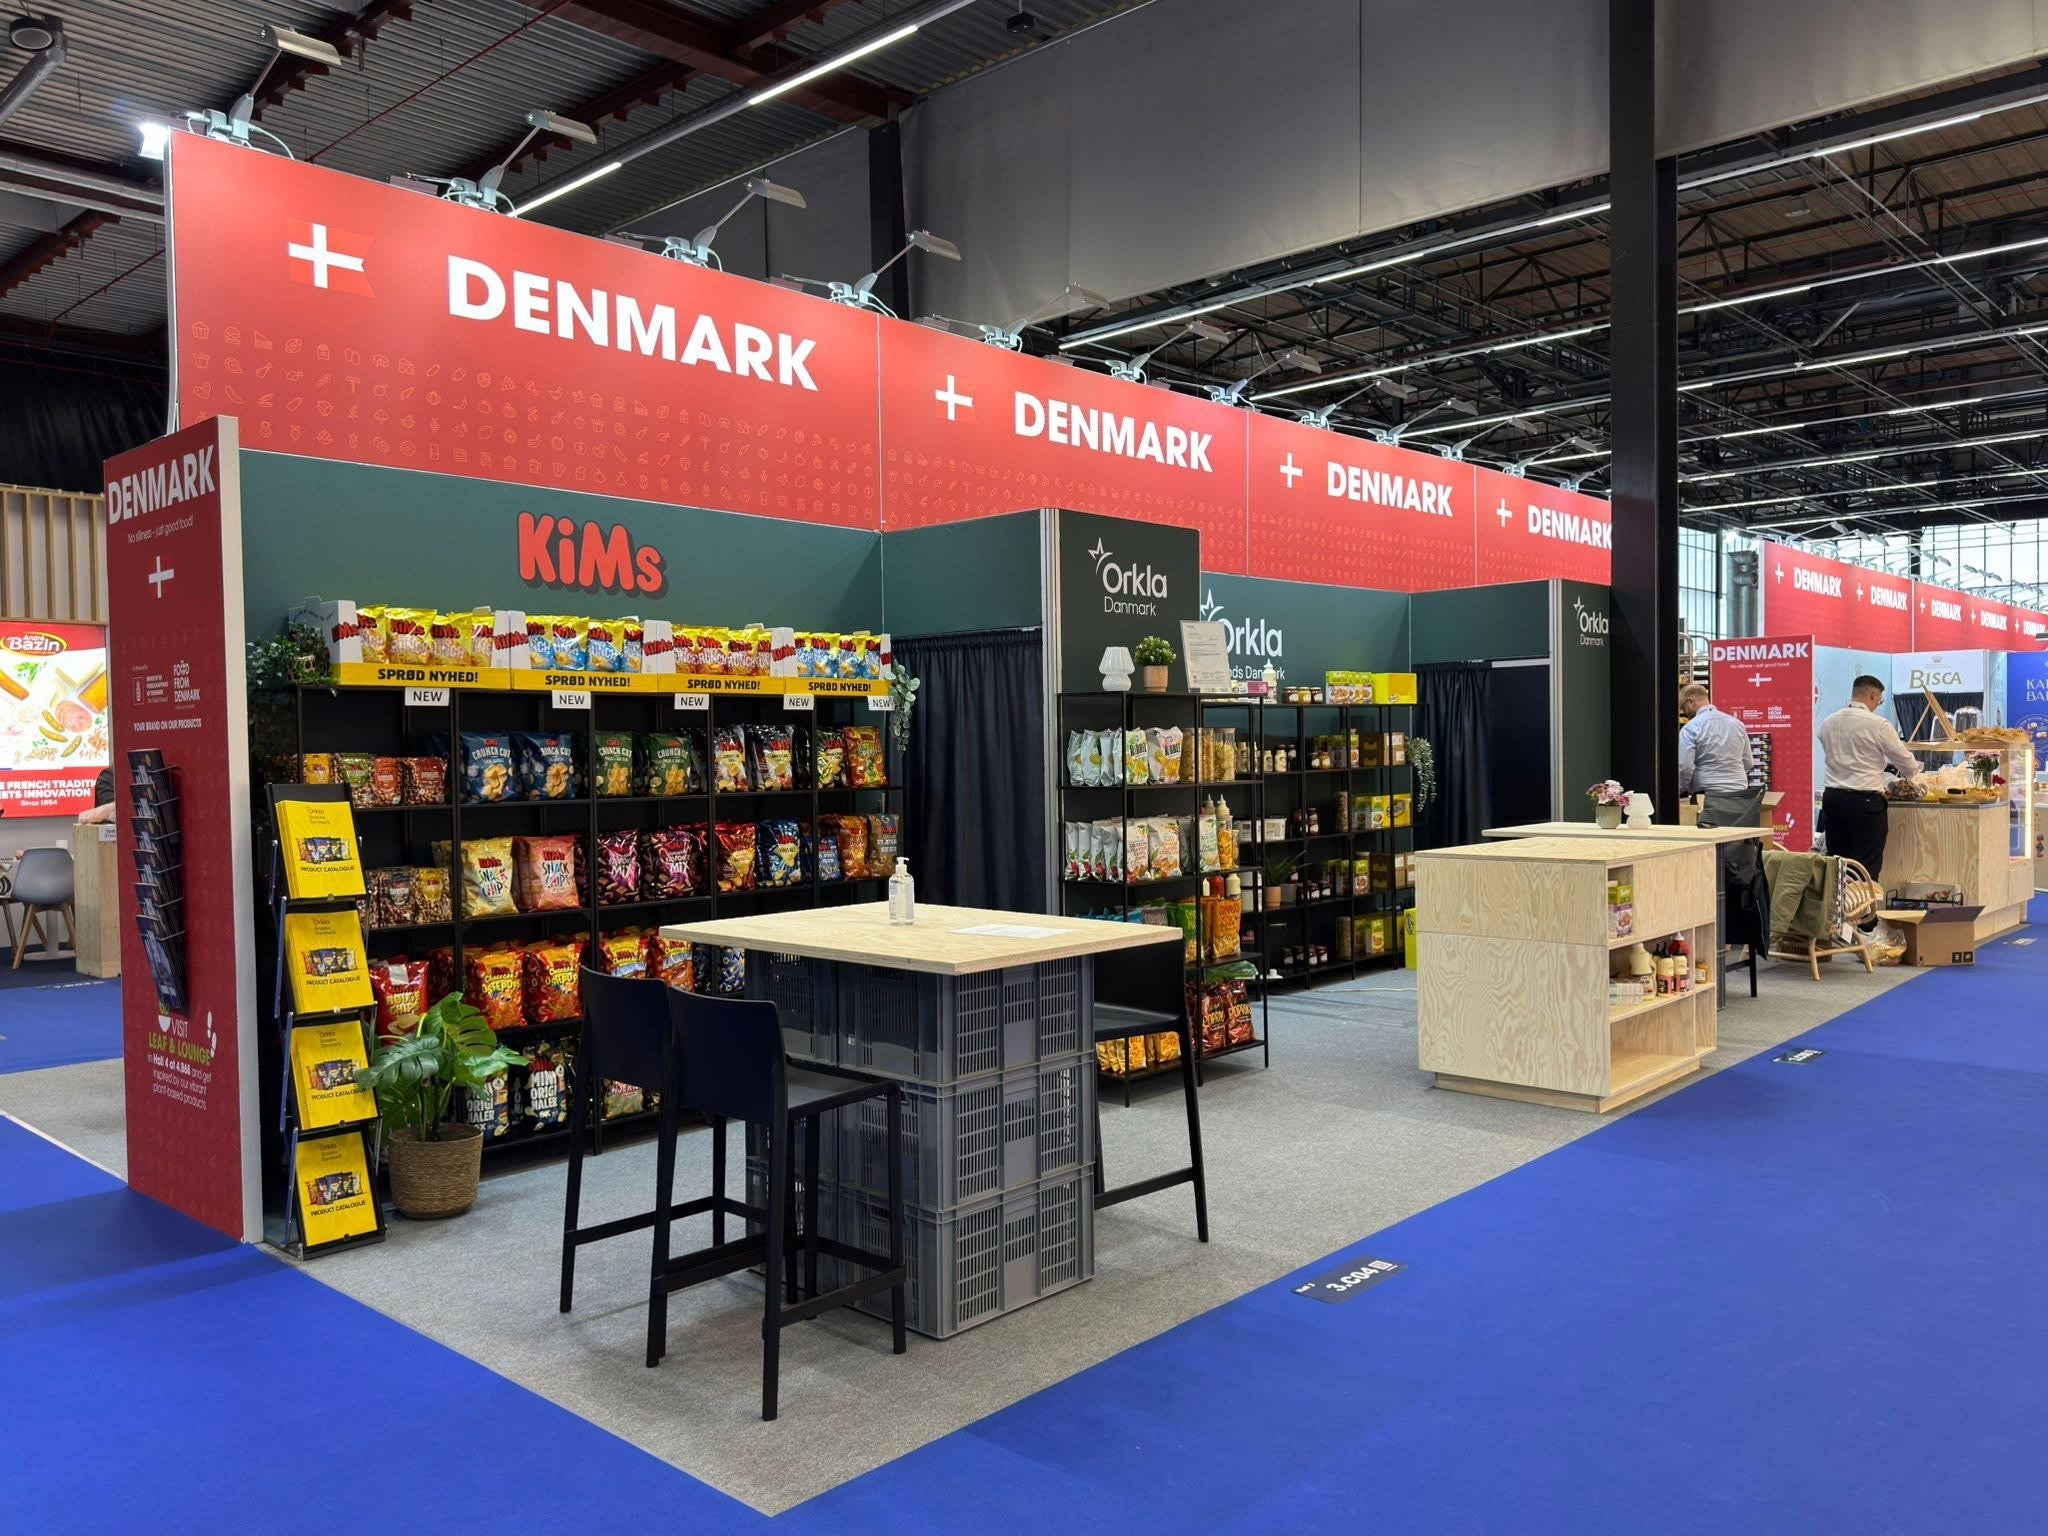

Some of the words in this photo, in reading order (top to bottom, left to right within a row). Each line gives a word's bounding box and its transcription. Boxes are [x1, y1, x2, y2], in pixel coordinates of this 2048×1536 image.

[447, 254, 819, 392] DENMARK
[1014, 389, 1214, 473] DENMARK
[108, 445, 215, 525] DENMARK
[1327, 461, 1453, 517] DENMARK
[1528, 504, 1612, 550] DENMARK
[518, 511, 664, 592] KiMs
[1103, 562, 1167, 598] Orkla
[1793, 566, 1842, 598] DENMARK
[1871, 585, 1908, 611] DENMARK
[1104, 596, 1157, 617] Danmark
[1931, 599, 1962, 622] DENMARK
[1580, 611, 1609, 634] Orkla
[1713, 642, 1809, 662] DENMARK
[174, 662, 190, 677] FOOD
[378, 668, 425, 681] SPRØD
[429, 671, 479, 683] NYHED!
[174, 677, 190, 689] FROM
[545, 675, 585, 686] SPRØD
[589, 677, 631, 687] NYHED!
[687, 679, 722, 689] SPRØD
[724, 681, 760, 690] NYHED!
[1910, 669, 1962, 689] BISCA
[808, 682, 838, 691] SPRØD
[840, 683, 871, 692] NYHED!
[174, 688, 201, 703] DENMARK
[413, 691, 443, 702] NEW
[559, 694, 585, 705] NEW
[680, 697, 704, 706] NEW
[789, 698, 810, 706] NEW
[872, 700, 890, 708] NEW
[133, 722, 145, 732] YOUR
[146, 721, 160, 731] BRAND
[160, 720, 168, 730] ON
[169, 719, 178, 729] OUR
[178, 718, 202, 729] PRODUCTS
[472, 746, 499, 760] CRUNCH
[7, 780, 51, 790] FRENCH
[52, 778, 97, 789] TRADITI
[24, 788, 91, 798] INNOVATION
[301, 865, 323, 873] PRODUCT
[323, 865, 355, 873] CATALOGUE
[542, 861, 569, 876] SNACK
[306, 978, 329, 986] PRODUCT
[329, 976, 361, 985] CATALOGUE
[172, 1018, 188, 1038] VISIT
[149, 1032, 167, 1051] LEAF
[177, 1040, 212, 1067] LOUNGE
[154, 1054, 164, 1067] Hall
[165, 1057, 169, 1068] 4
[530, 1070, 558, 1088] MINI
[311, 1092, 335, 1101] PRODUCT
[530, 1085, 558, 1100] ORIGI
[310, 1205, 335, 1217] PRODUCT
[335, 1199, 367, 1213] CATALOGUE
[1326, 1266, 1380, 1292] 3.C04
